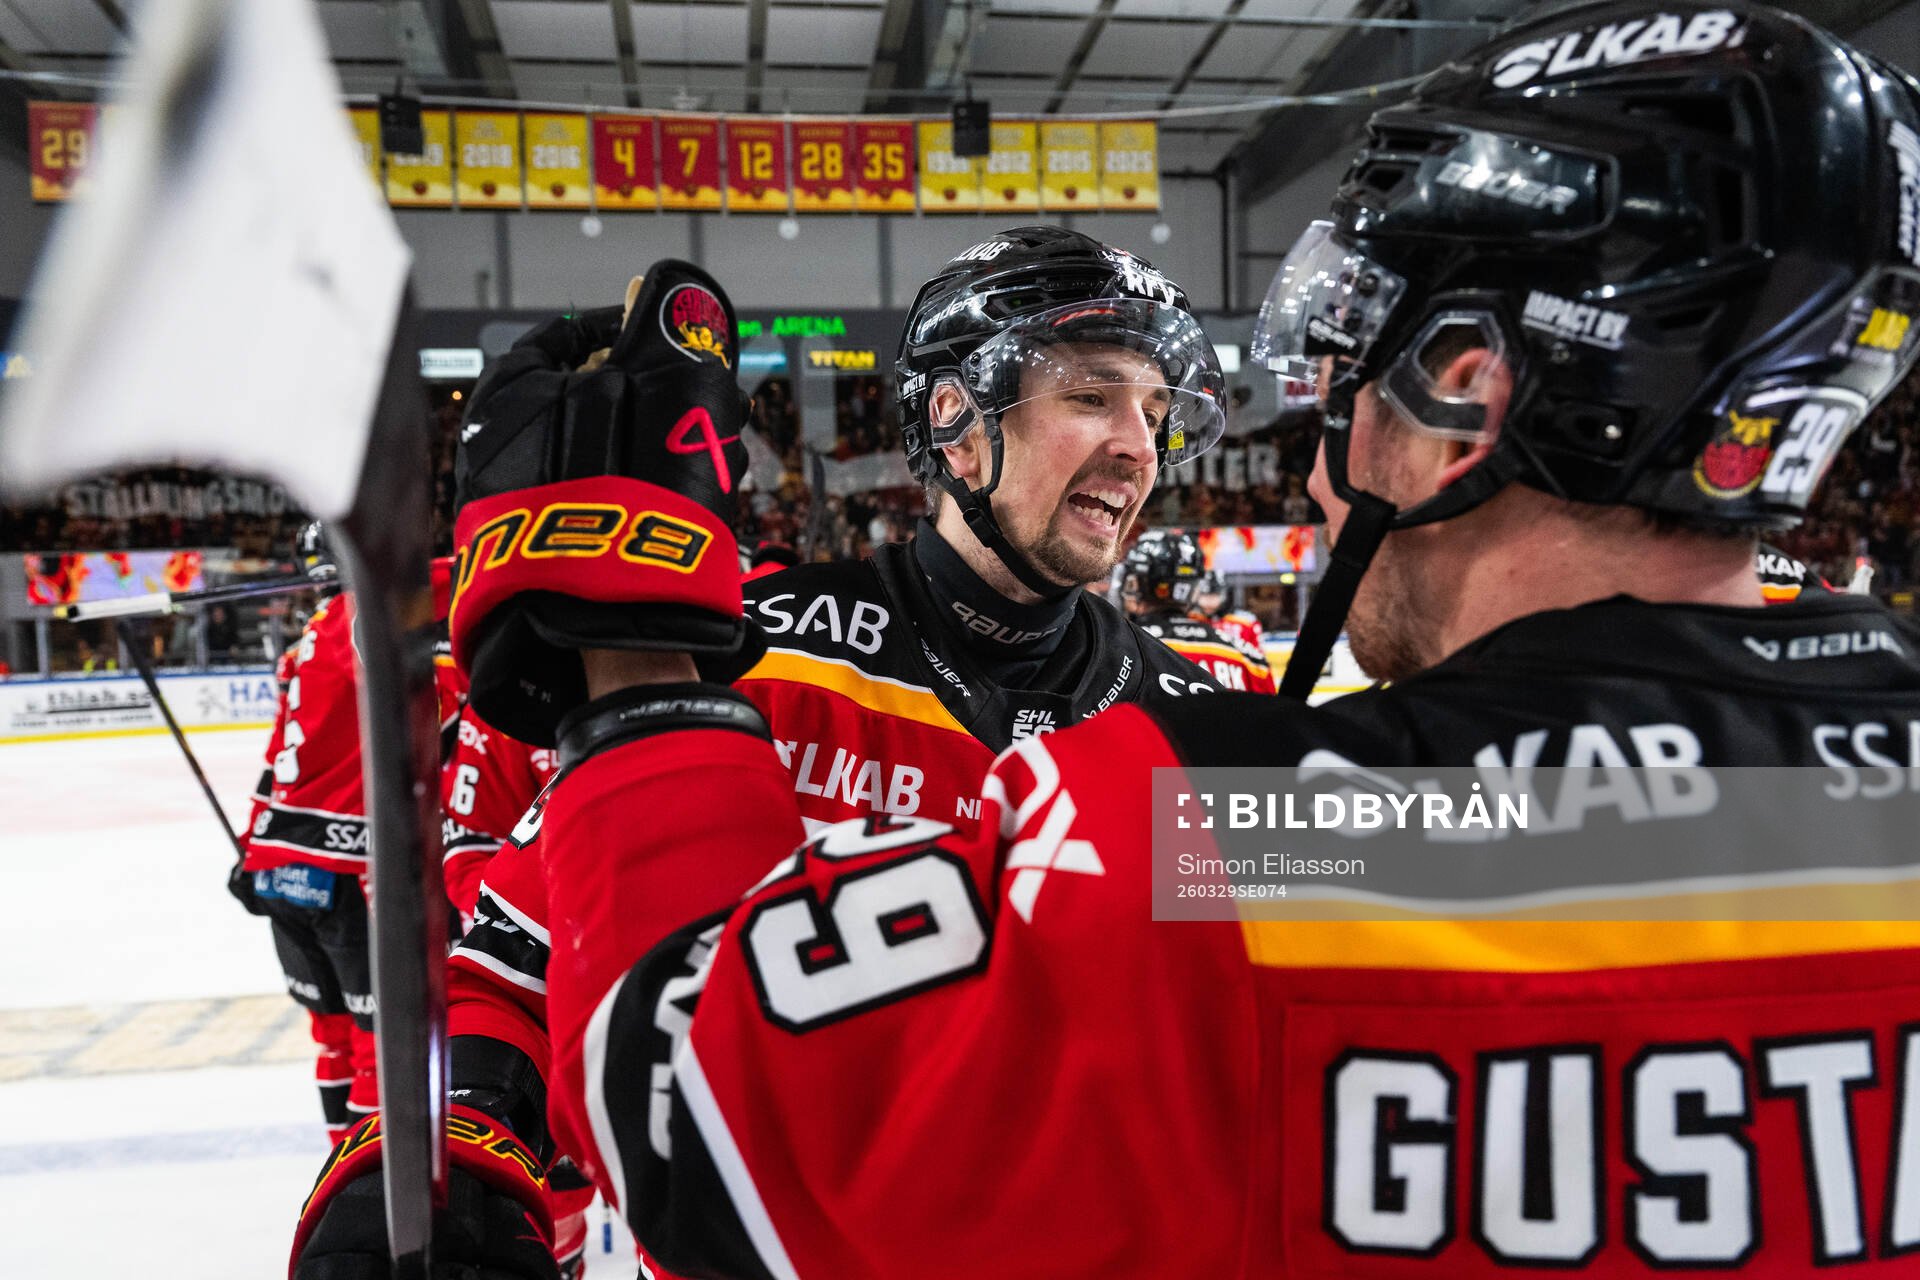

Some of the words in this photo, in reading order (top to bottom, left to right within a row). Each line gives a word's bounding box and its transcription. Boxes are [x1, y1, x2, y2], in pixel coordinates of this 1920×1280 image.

[1545, 10, 1737, 77] LKAB
[42, 128, 88, 169] 29
[613, 138, 636, 178] 4
[678, 138, 699, 177] 7
[738, 140, 774, 180] 12
[801, 141, 844, 181] 28
[862, 142, 906, 181] 35
[771, 315, 847, 338] ARENA
[1760, 402, 1852, 494] 29
[741, 592, 891, 656] SAB
[1014, 709, 1056, 725] SHL
[795, 742, 925, 817] LKAB
